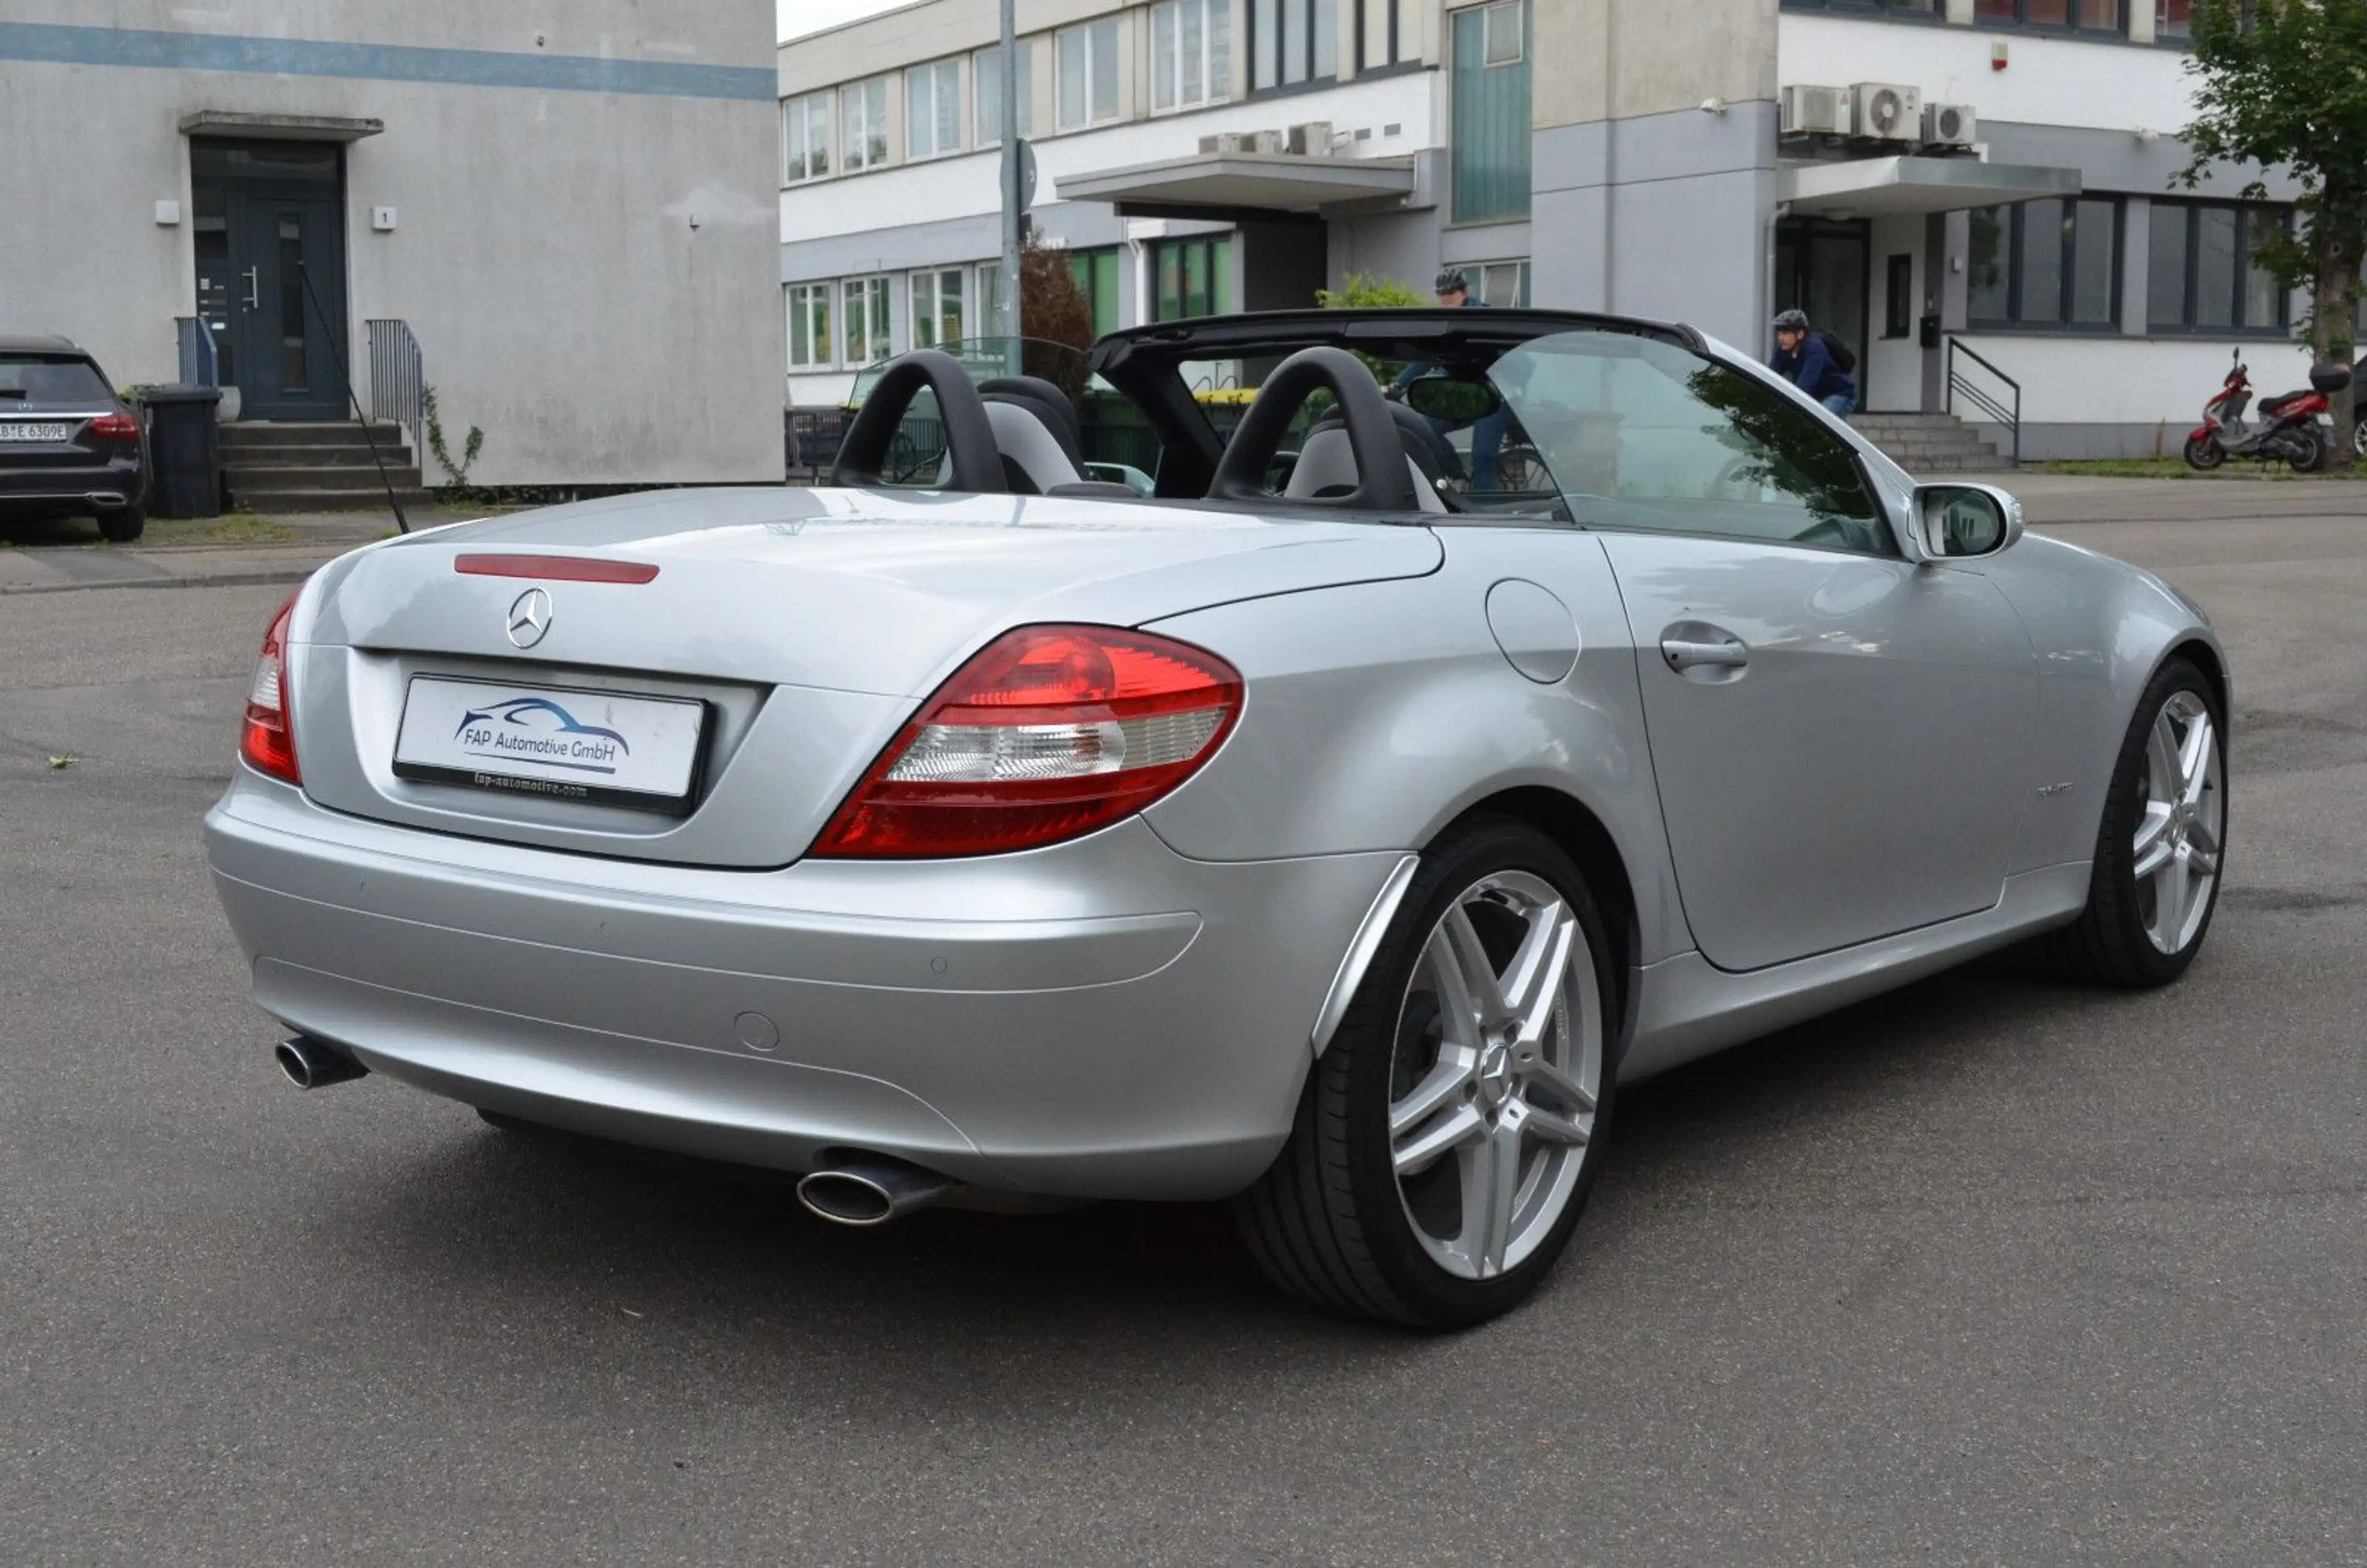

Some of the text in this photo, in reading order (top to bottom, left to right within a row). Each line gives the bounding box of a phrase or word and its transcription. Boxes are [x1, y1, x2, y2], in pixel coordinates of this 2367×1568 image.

[464, 729, 616, 762] FAP Automotive GmbH
[474, 772, 587, 796] fap-automotive.com
